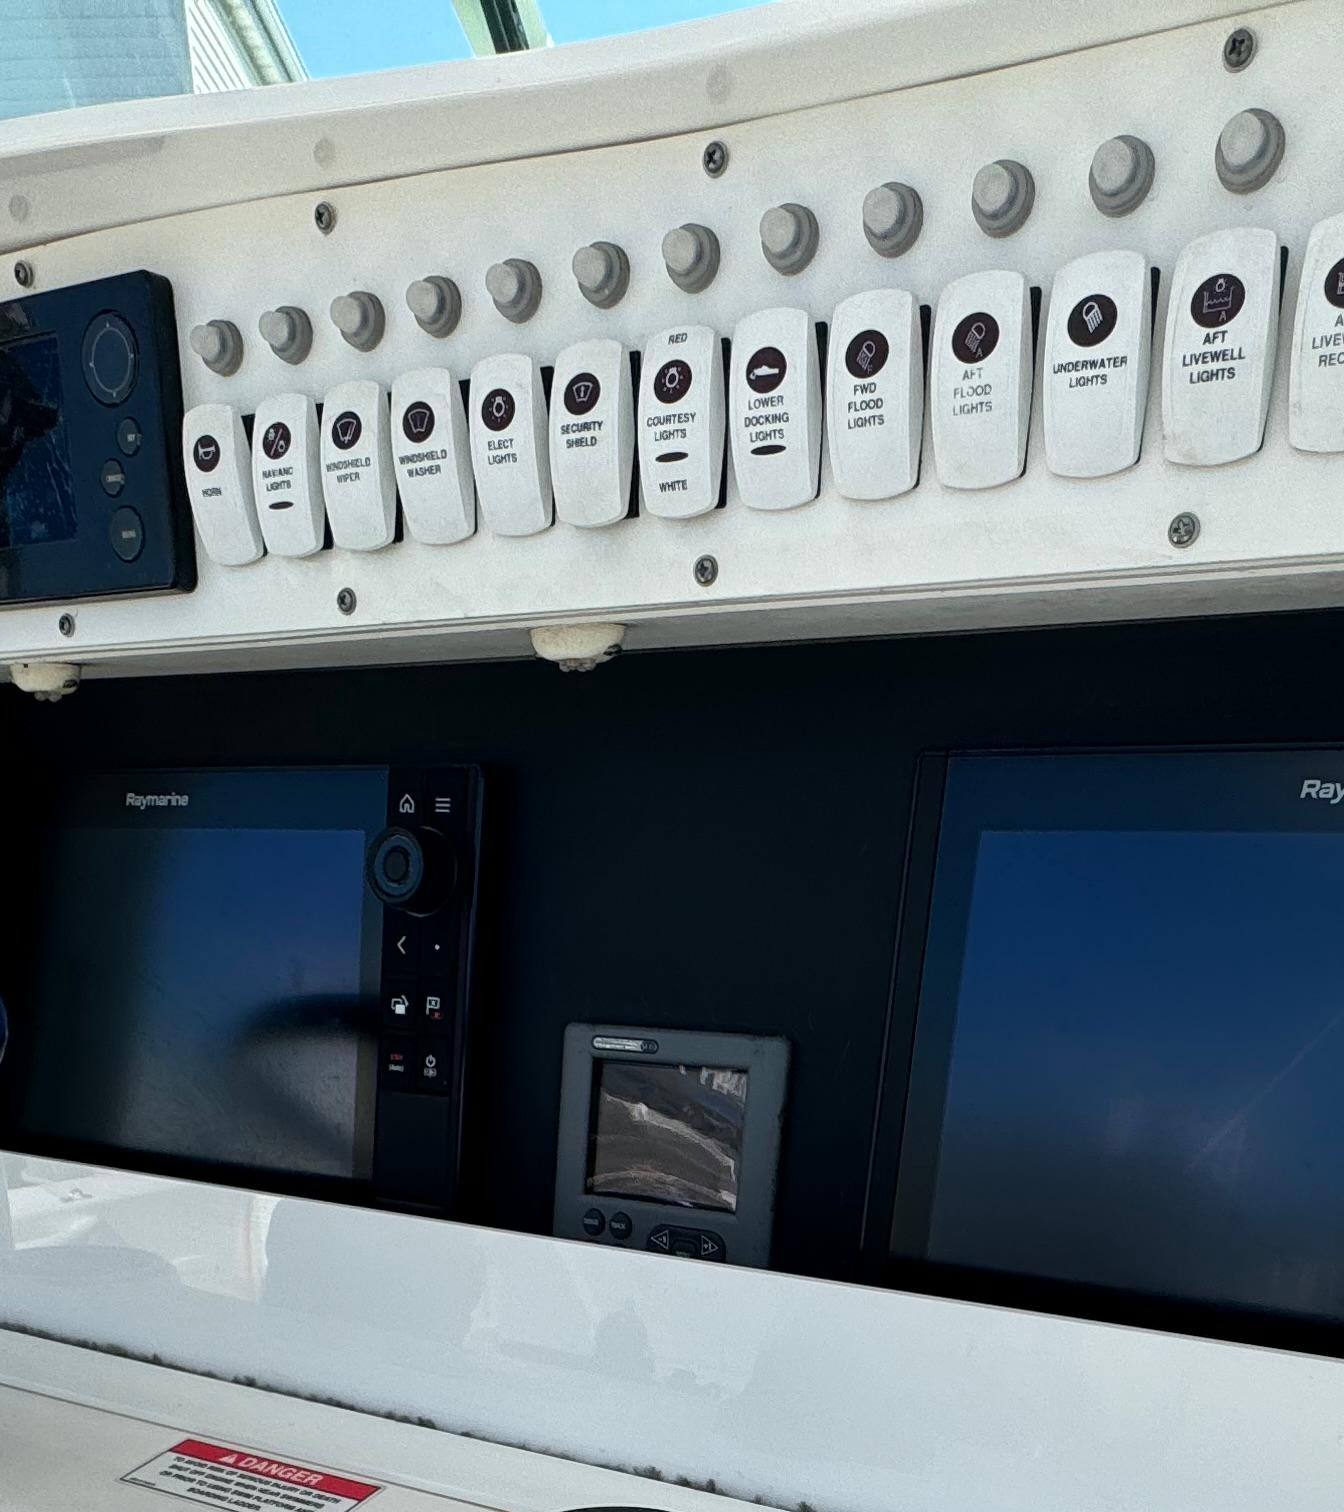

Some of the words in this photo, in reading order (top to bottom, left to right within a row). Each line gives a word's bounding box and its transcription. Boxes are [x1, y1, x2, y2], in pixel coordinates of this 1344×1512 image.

[1202, 330, 1227, 346] AFT
[1052, 355, 1128, 375] UNDERWATER
[1182, 347, 1246, 368] LIVEWELL
[962, 367, 984, 382] AFT
[1068, 373, 1108, 389] LIGHTS
[1189, 367, 1236, 385] LIGHTS
[853, 382, 877, 396] FWD
[953, 383, 992, 399] FLOOD
[747, 395, 785, 411] LOWER
[847, 398, 884, 414] FLOOD
[952, 401, 993, 417] LIGHTS
[646, 411, 697, 428] COURTESY
[744, 412, 790, 428] DOCKING
[847, 414, 885, 430] LIGHTS
[560, 420, 604, 436] SECURITY
[654, 428, 687, 442] LIGHTS
[749, 428, 785, 444] LIGHTS
[487, 438, 514, 451] ELECT
[566, 436, 597, 449] SHIELD
[398, 449, 448, 466] WINDSHIELD
[487, 453, 518, 466] LIGHTS
[407, 464, 442, 478] WASHER
[658, 479, 688, 493] WHITE
[125, 791, 190, 810] Raymarine
[241, 1456, 323, 1486] DANGER
